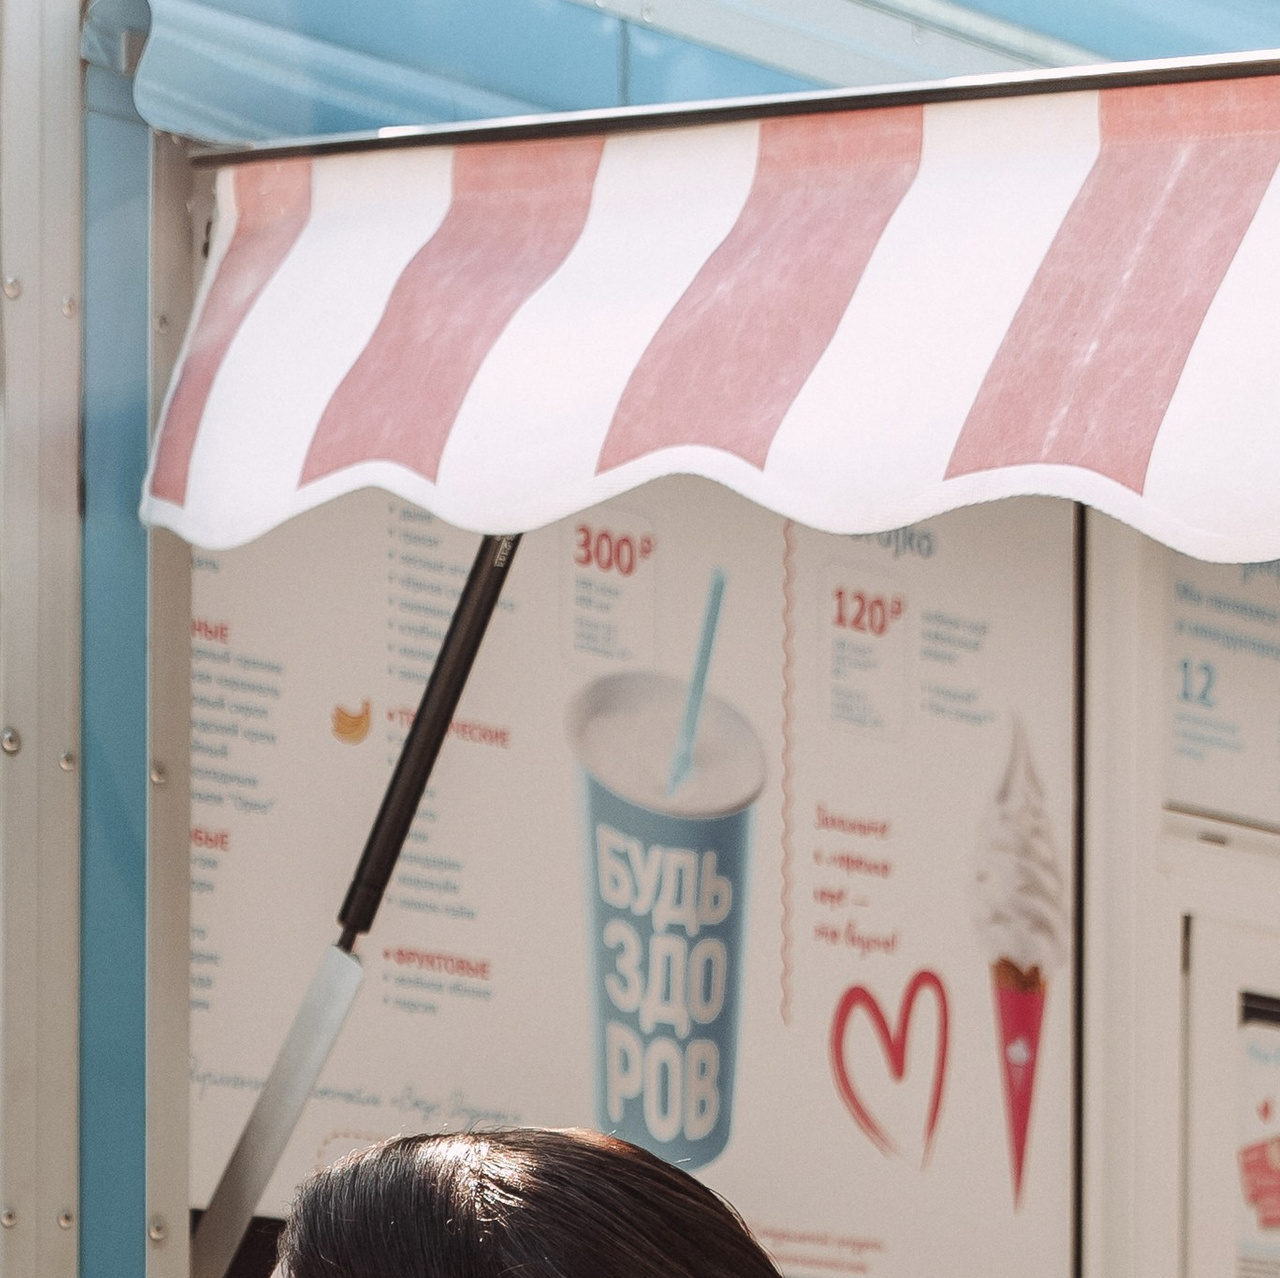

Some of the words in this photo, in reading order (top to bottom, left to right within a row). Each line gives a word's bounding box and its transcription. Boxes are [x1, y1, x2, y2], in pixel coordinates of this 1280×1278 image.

[596, 822, 733, 937] БУДЬ
[603, 918, 727, 1040] ЗДО
[606, 1021, 721, 1142] РОВ
